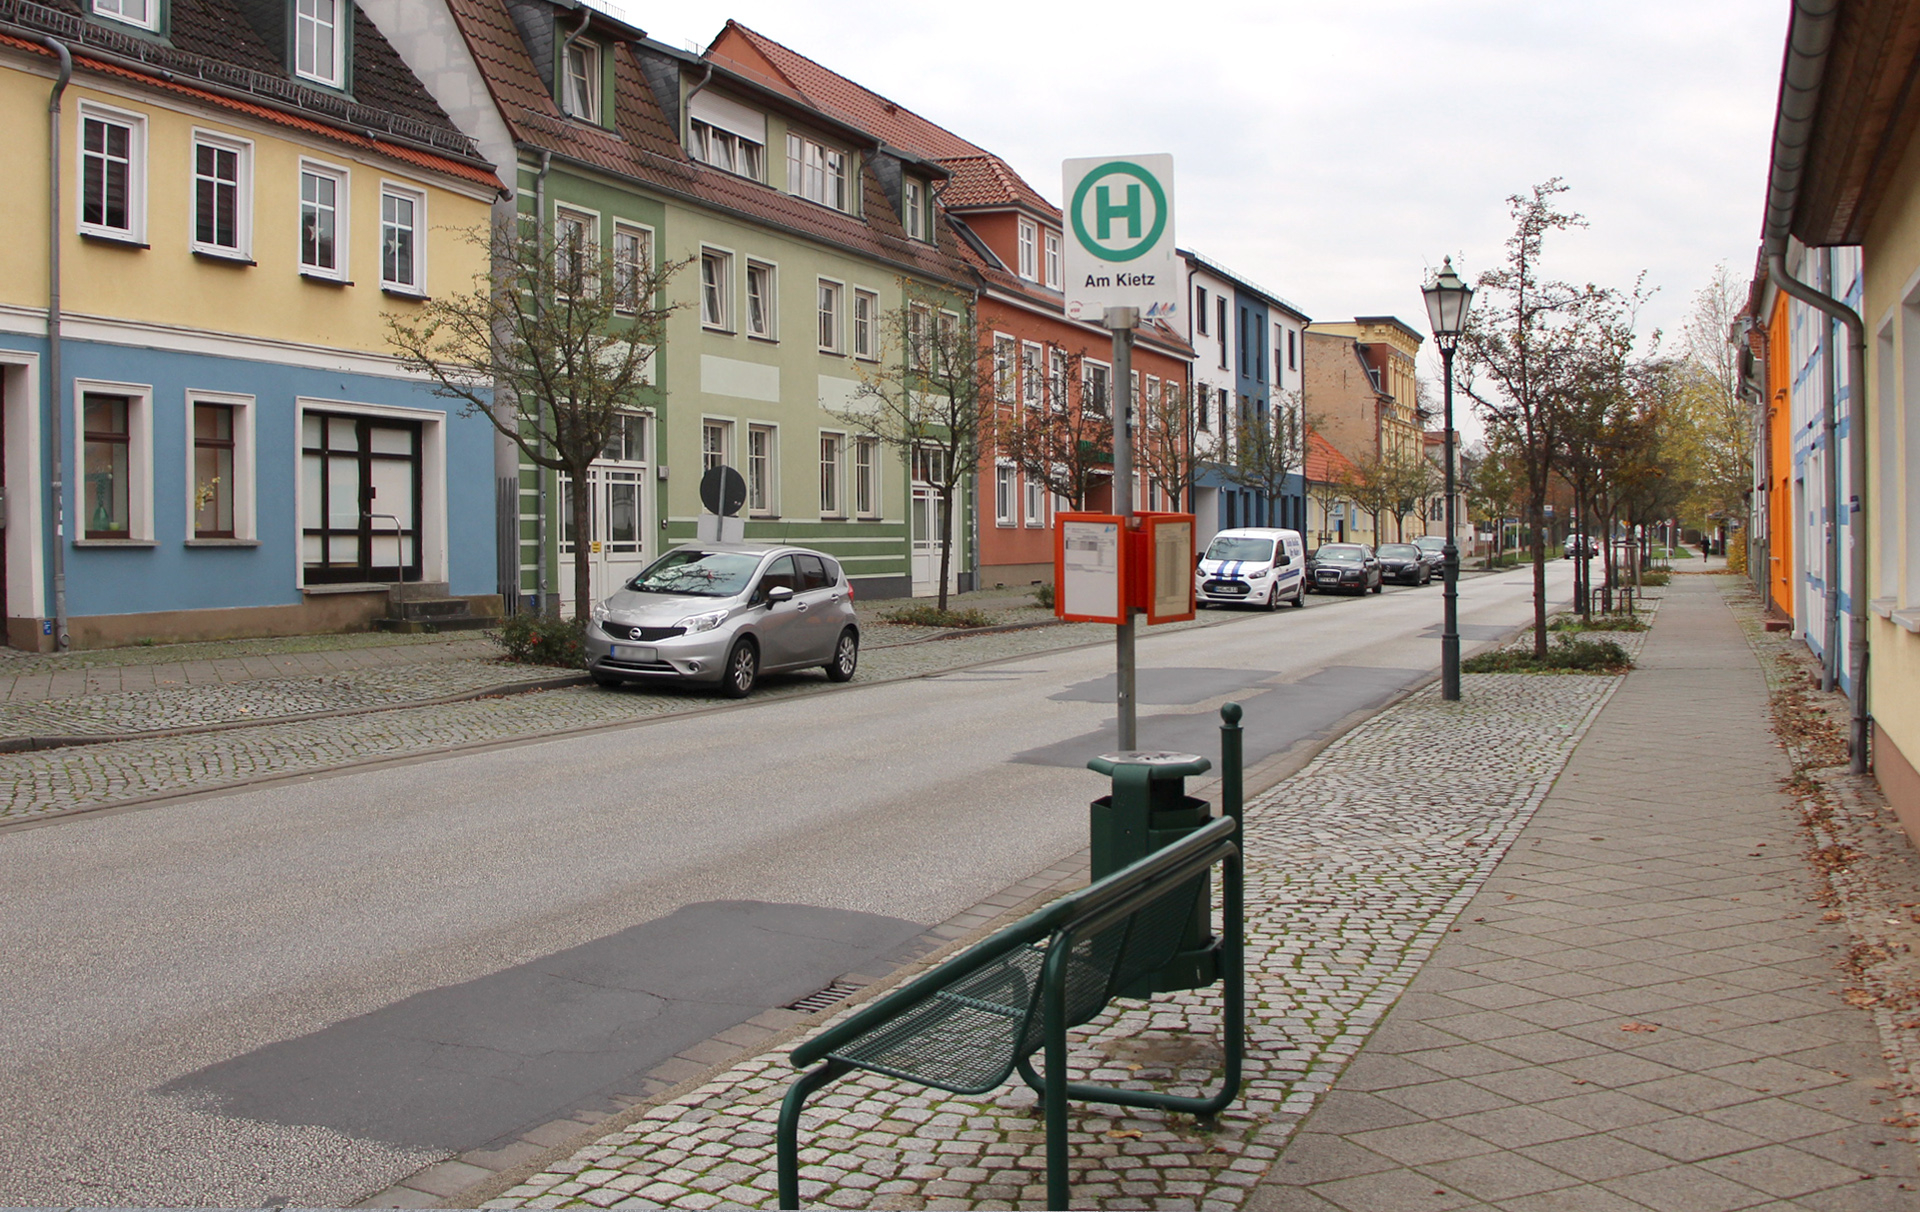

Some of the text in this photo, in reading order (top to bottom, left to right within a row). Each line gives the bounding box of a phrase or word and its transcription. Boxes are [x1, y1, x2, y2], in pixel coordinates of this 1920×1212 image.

[1096, 184, 1142, 240] H
[1085, 272, 1155, 288] Am Kietz
